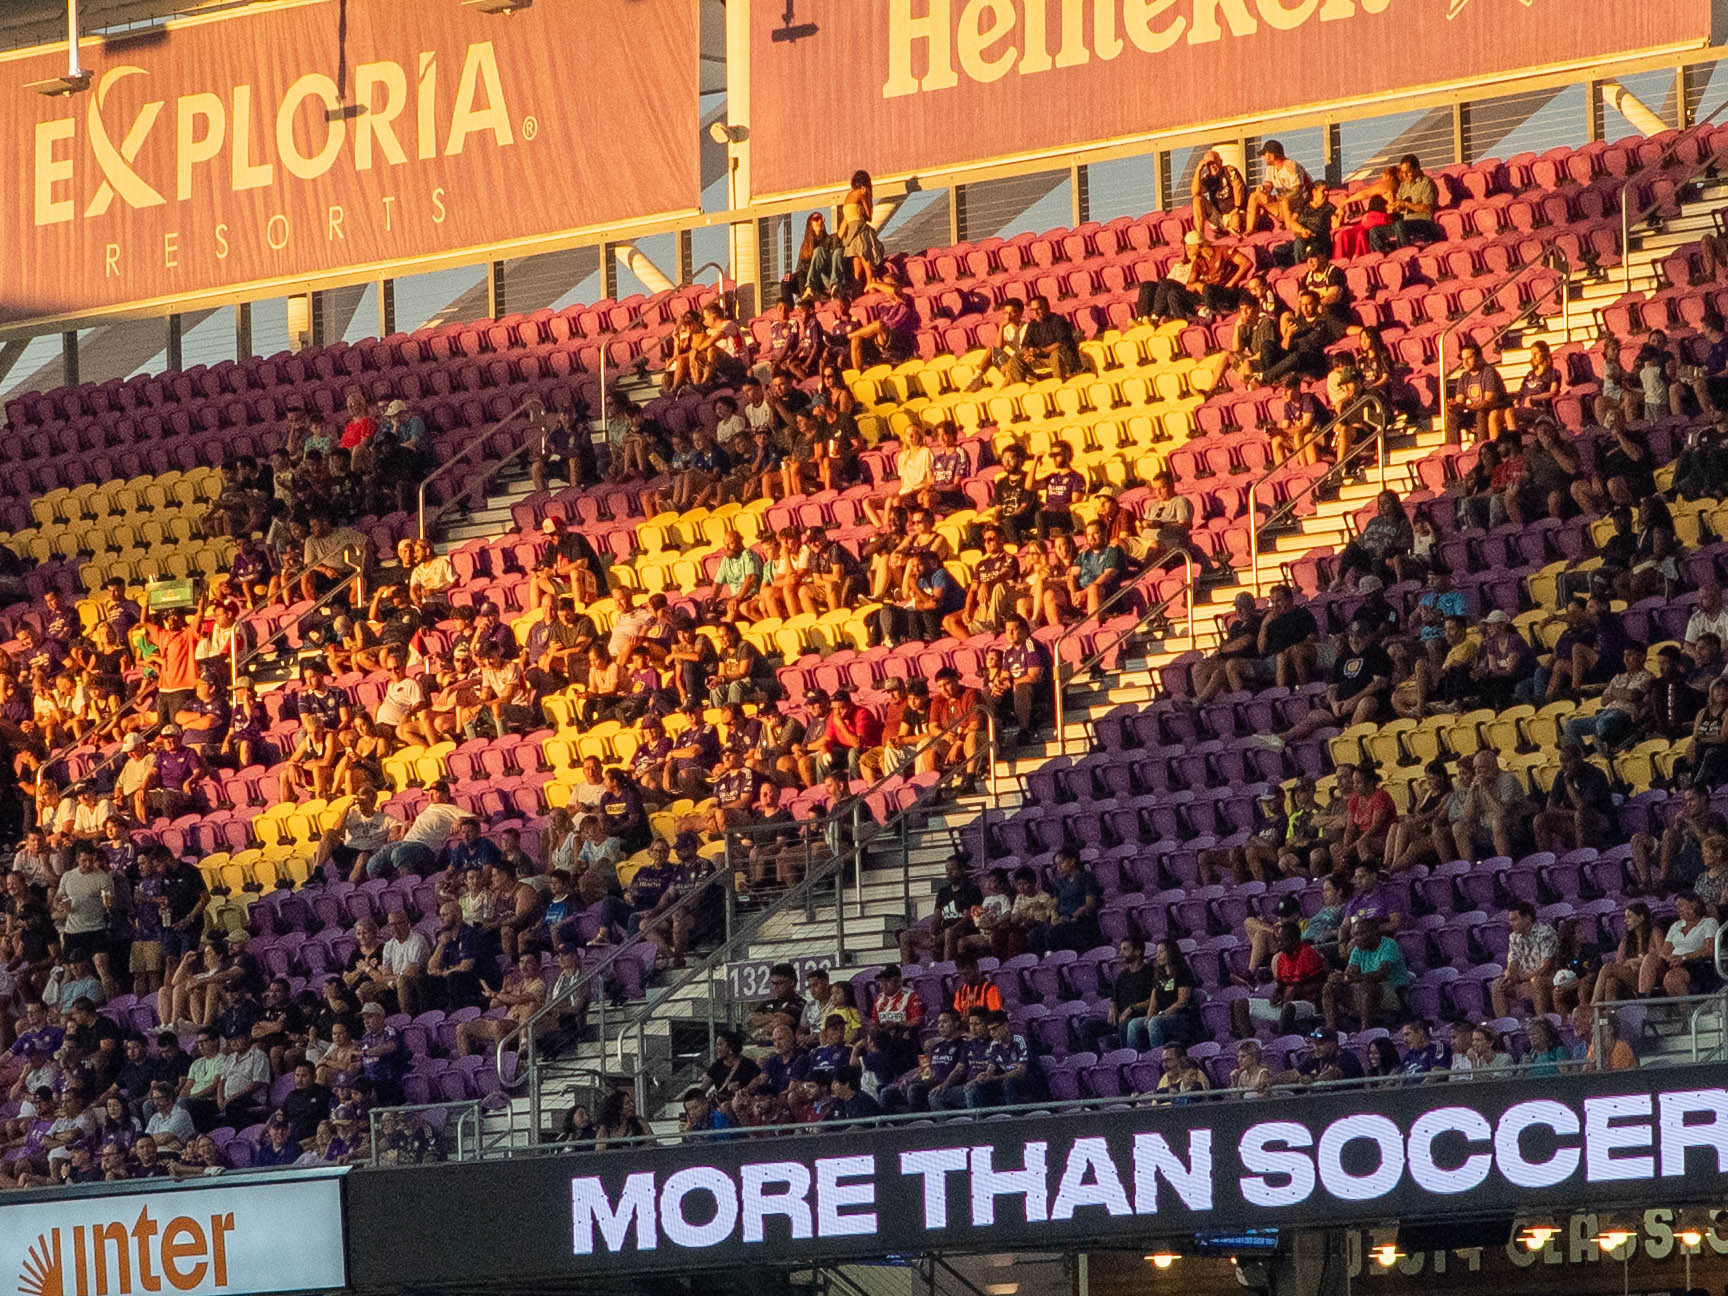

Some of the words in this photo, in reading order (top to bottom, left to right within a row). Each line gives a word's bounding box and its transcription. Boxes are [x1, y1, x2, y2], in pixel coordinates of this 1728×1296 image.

[34, 40, 516, 227] EXPLORIA
[106, 186, 448, 275] RESORTS
[729, 960, 771, 998] 132
[570, 1153, 879, 1256] MORE
[900, 1128, 1215, 1230] THAN
